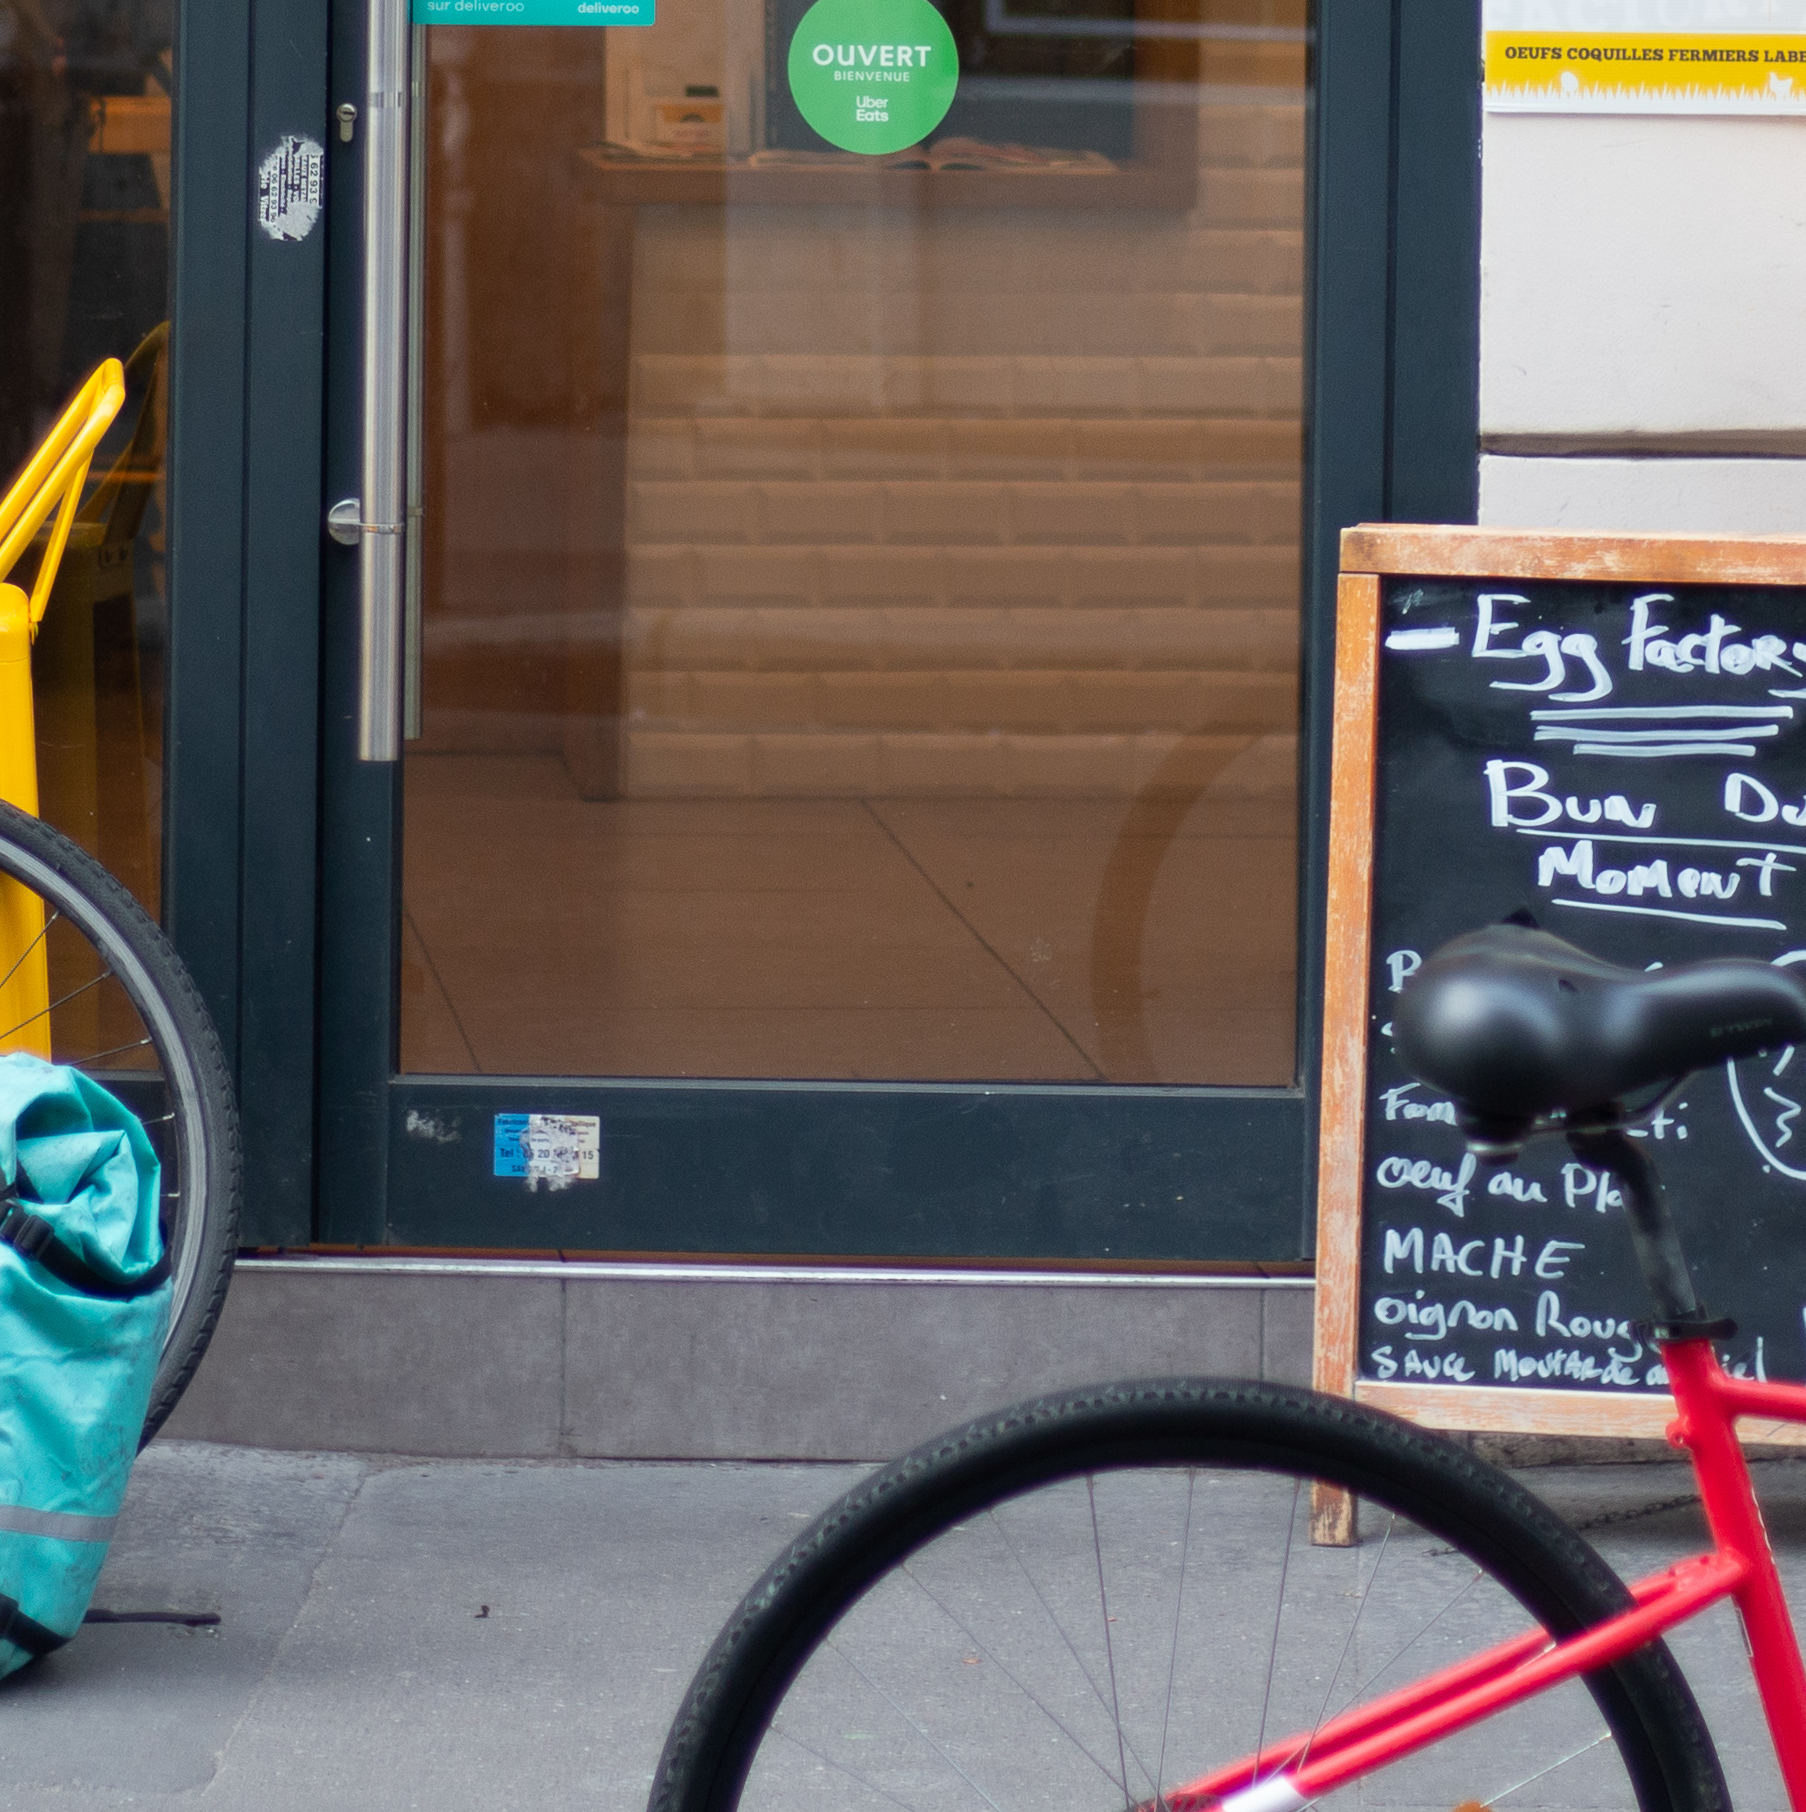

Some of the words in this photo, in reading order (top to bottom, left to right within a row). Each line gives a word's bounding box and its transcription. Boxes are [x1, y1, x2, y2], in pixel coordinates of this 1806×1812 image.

[427, 0, 451, 12] sur
[577, 2, 640, 15] deliveroo
[813, 45, 932, 67] OUVERT
[1505, 47, 1562, 60] OEUFS
[1567, 47, 1664, 62] COQUILLES
[1669, 49, 1760, 63] FERMIERS
[834, 71, 911, 83] BIENVENUE
[856, 95, 888, 110] Uber
[856, 109, 888, 122] Eats
[1384, 1228, 1585, 1278] MACHE
